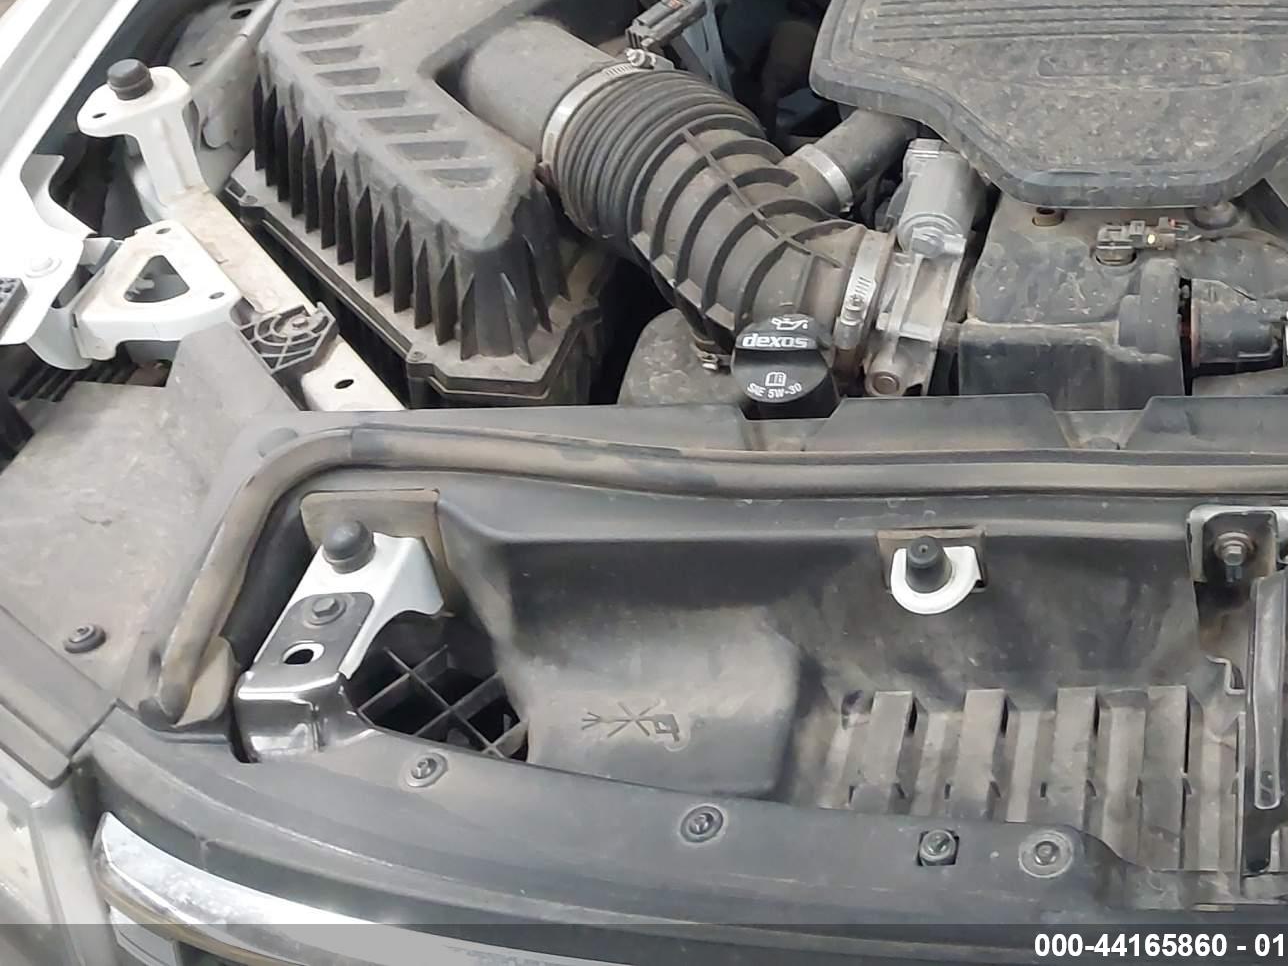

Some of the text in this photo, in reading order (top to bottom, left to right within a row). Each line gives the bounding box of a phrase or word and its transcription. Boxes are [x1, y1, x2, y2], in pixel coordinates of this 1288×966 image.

[742, 333, 809, 349] dexos
[747, 382, 803, 399] SAE 5W-30
